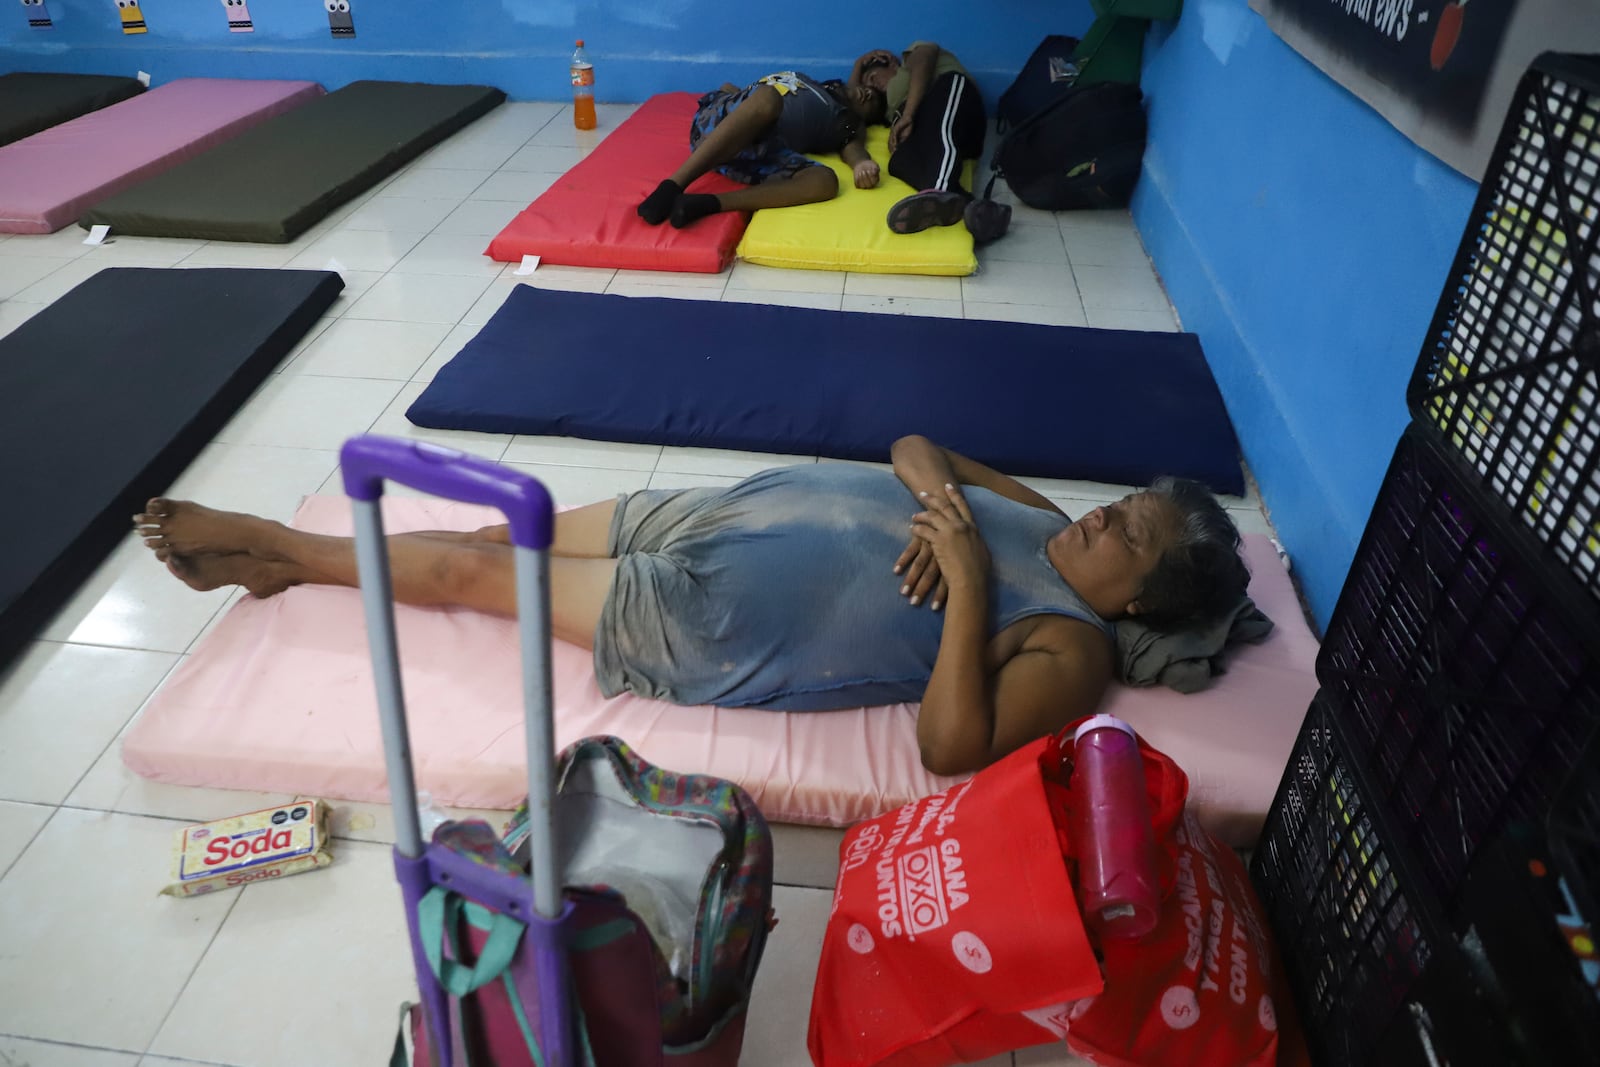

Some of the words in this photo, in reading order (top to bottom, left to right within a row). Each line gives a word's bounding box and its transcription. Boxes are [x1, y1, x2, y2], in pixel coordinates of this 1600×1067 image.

[203, 828, 292, 865] Soda
[846, 824, 882, 870] spin
[940, 838, 970, 911] GANA
[225, 869, 281, 886] Soda
[876, 847, 902, 938] PUNTOS
[904, 850, 940, 930] OXXO
[1205, 899, 1225, 973] PAGA
[1201, 972, 1219, 992] Y
[1229, 943, 1248, 1004] CON
